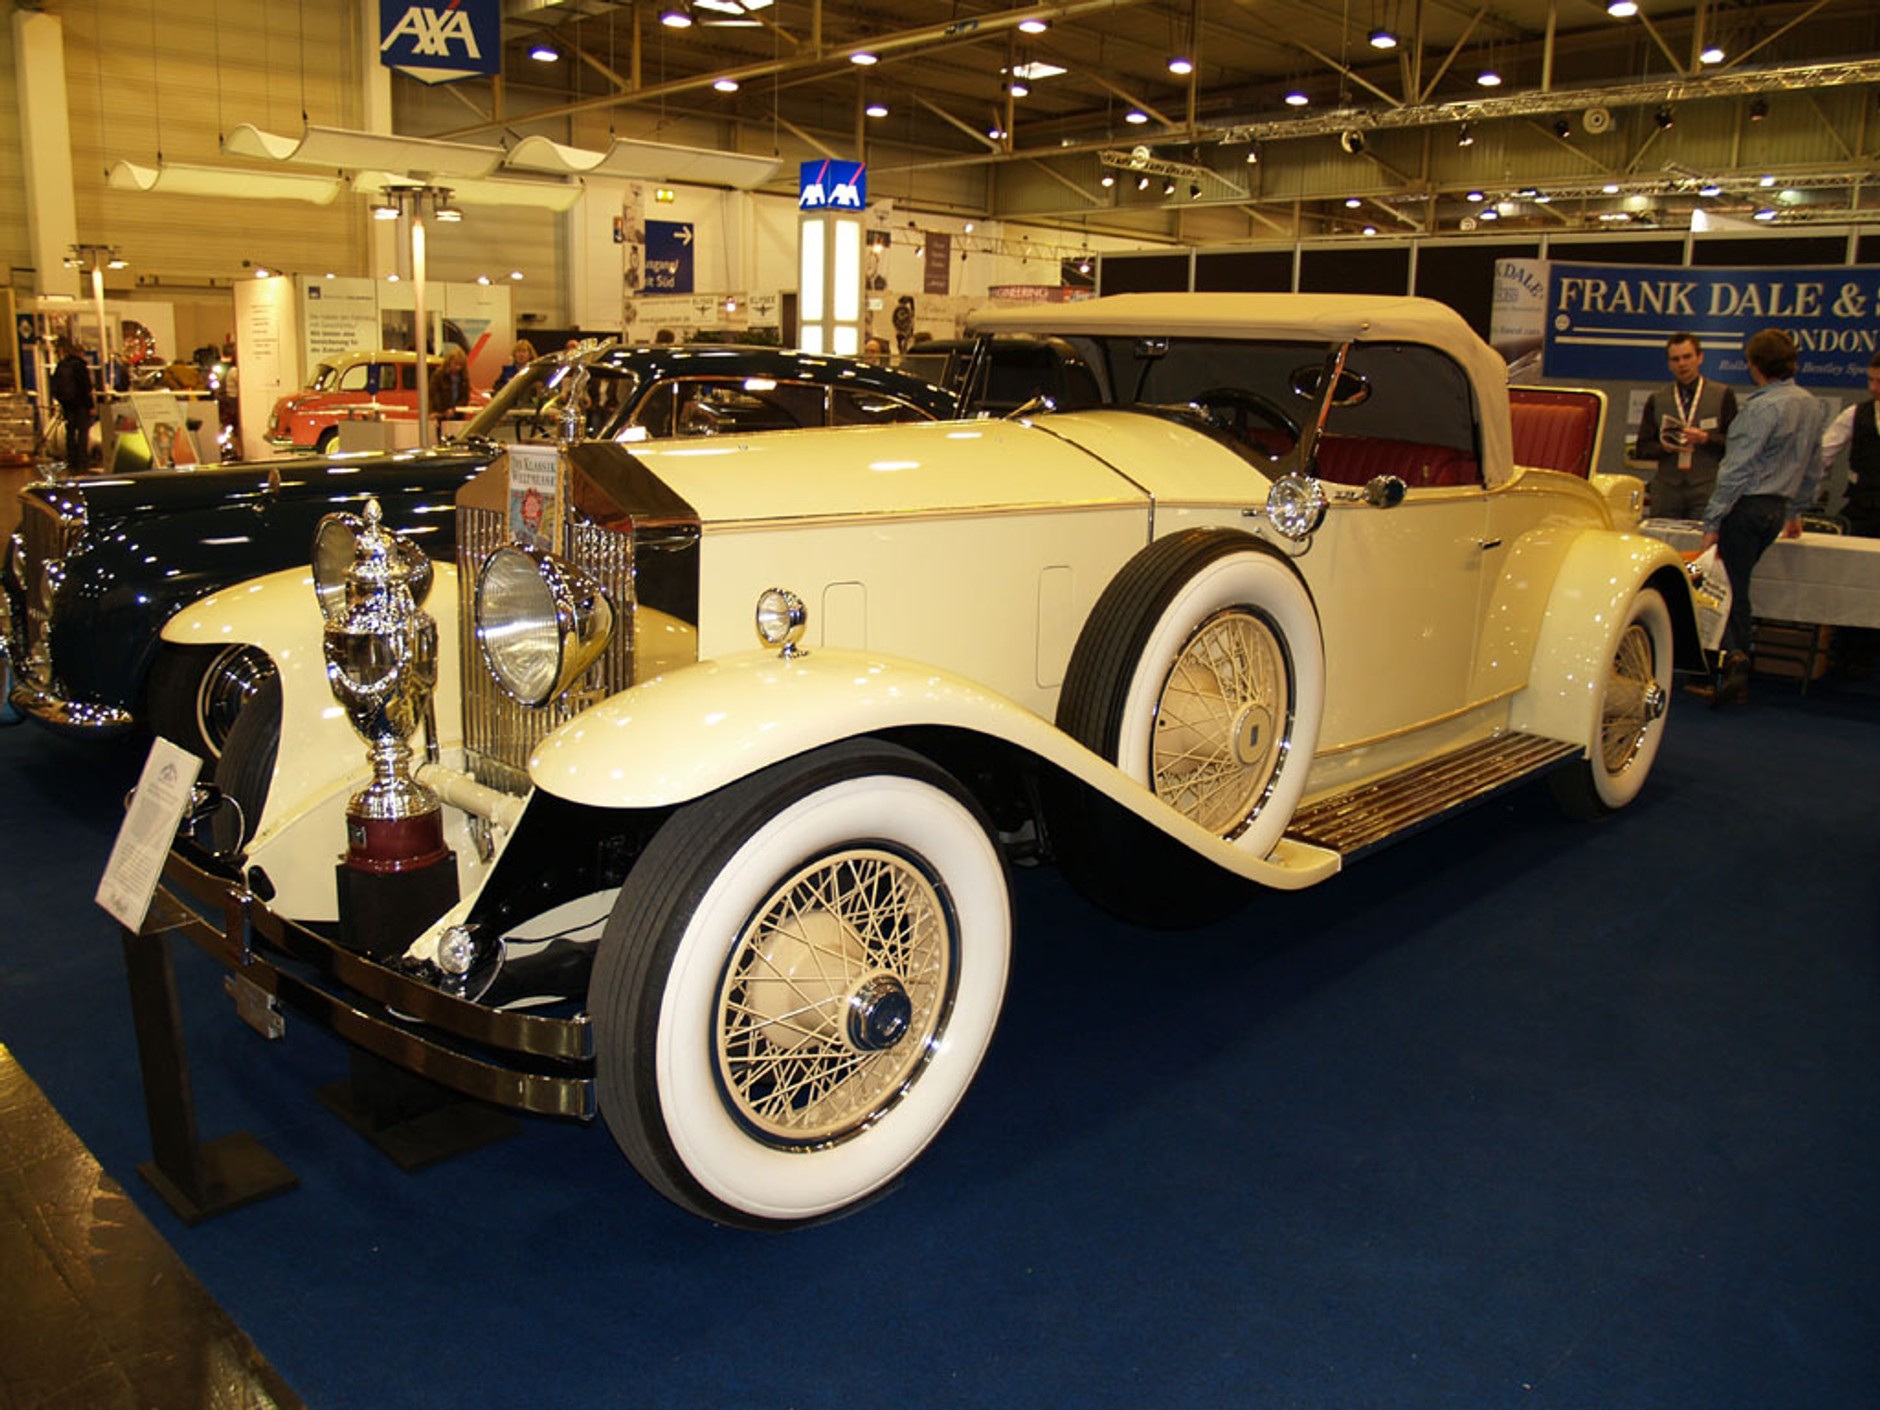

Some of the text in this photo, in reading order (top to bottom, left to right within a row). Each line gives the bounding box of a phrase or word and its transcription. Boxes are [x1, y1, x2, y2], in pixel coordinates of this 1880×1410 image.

[380, 6, 482, 58] AXA
[1557, 277, 1698, 315] FRANK
[1707, 282, 1823, 317] DALE
[1832, 282, 1867, 318] &
[1786, 328, 1878, 352] ONDON
[1802, 361, 1843, 375] Bentley
